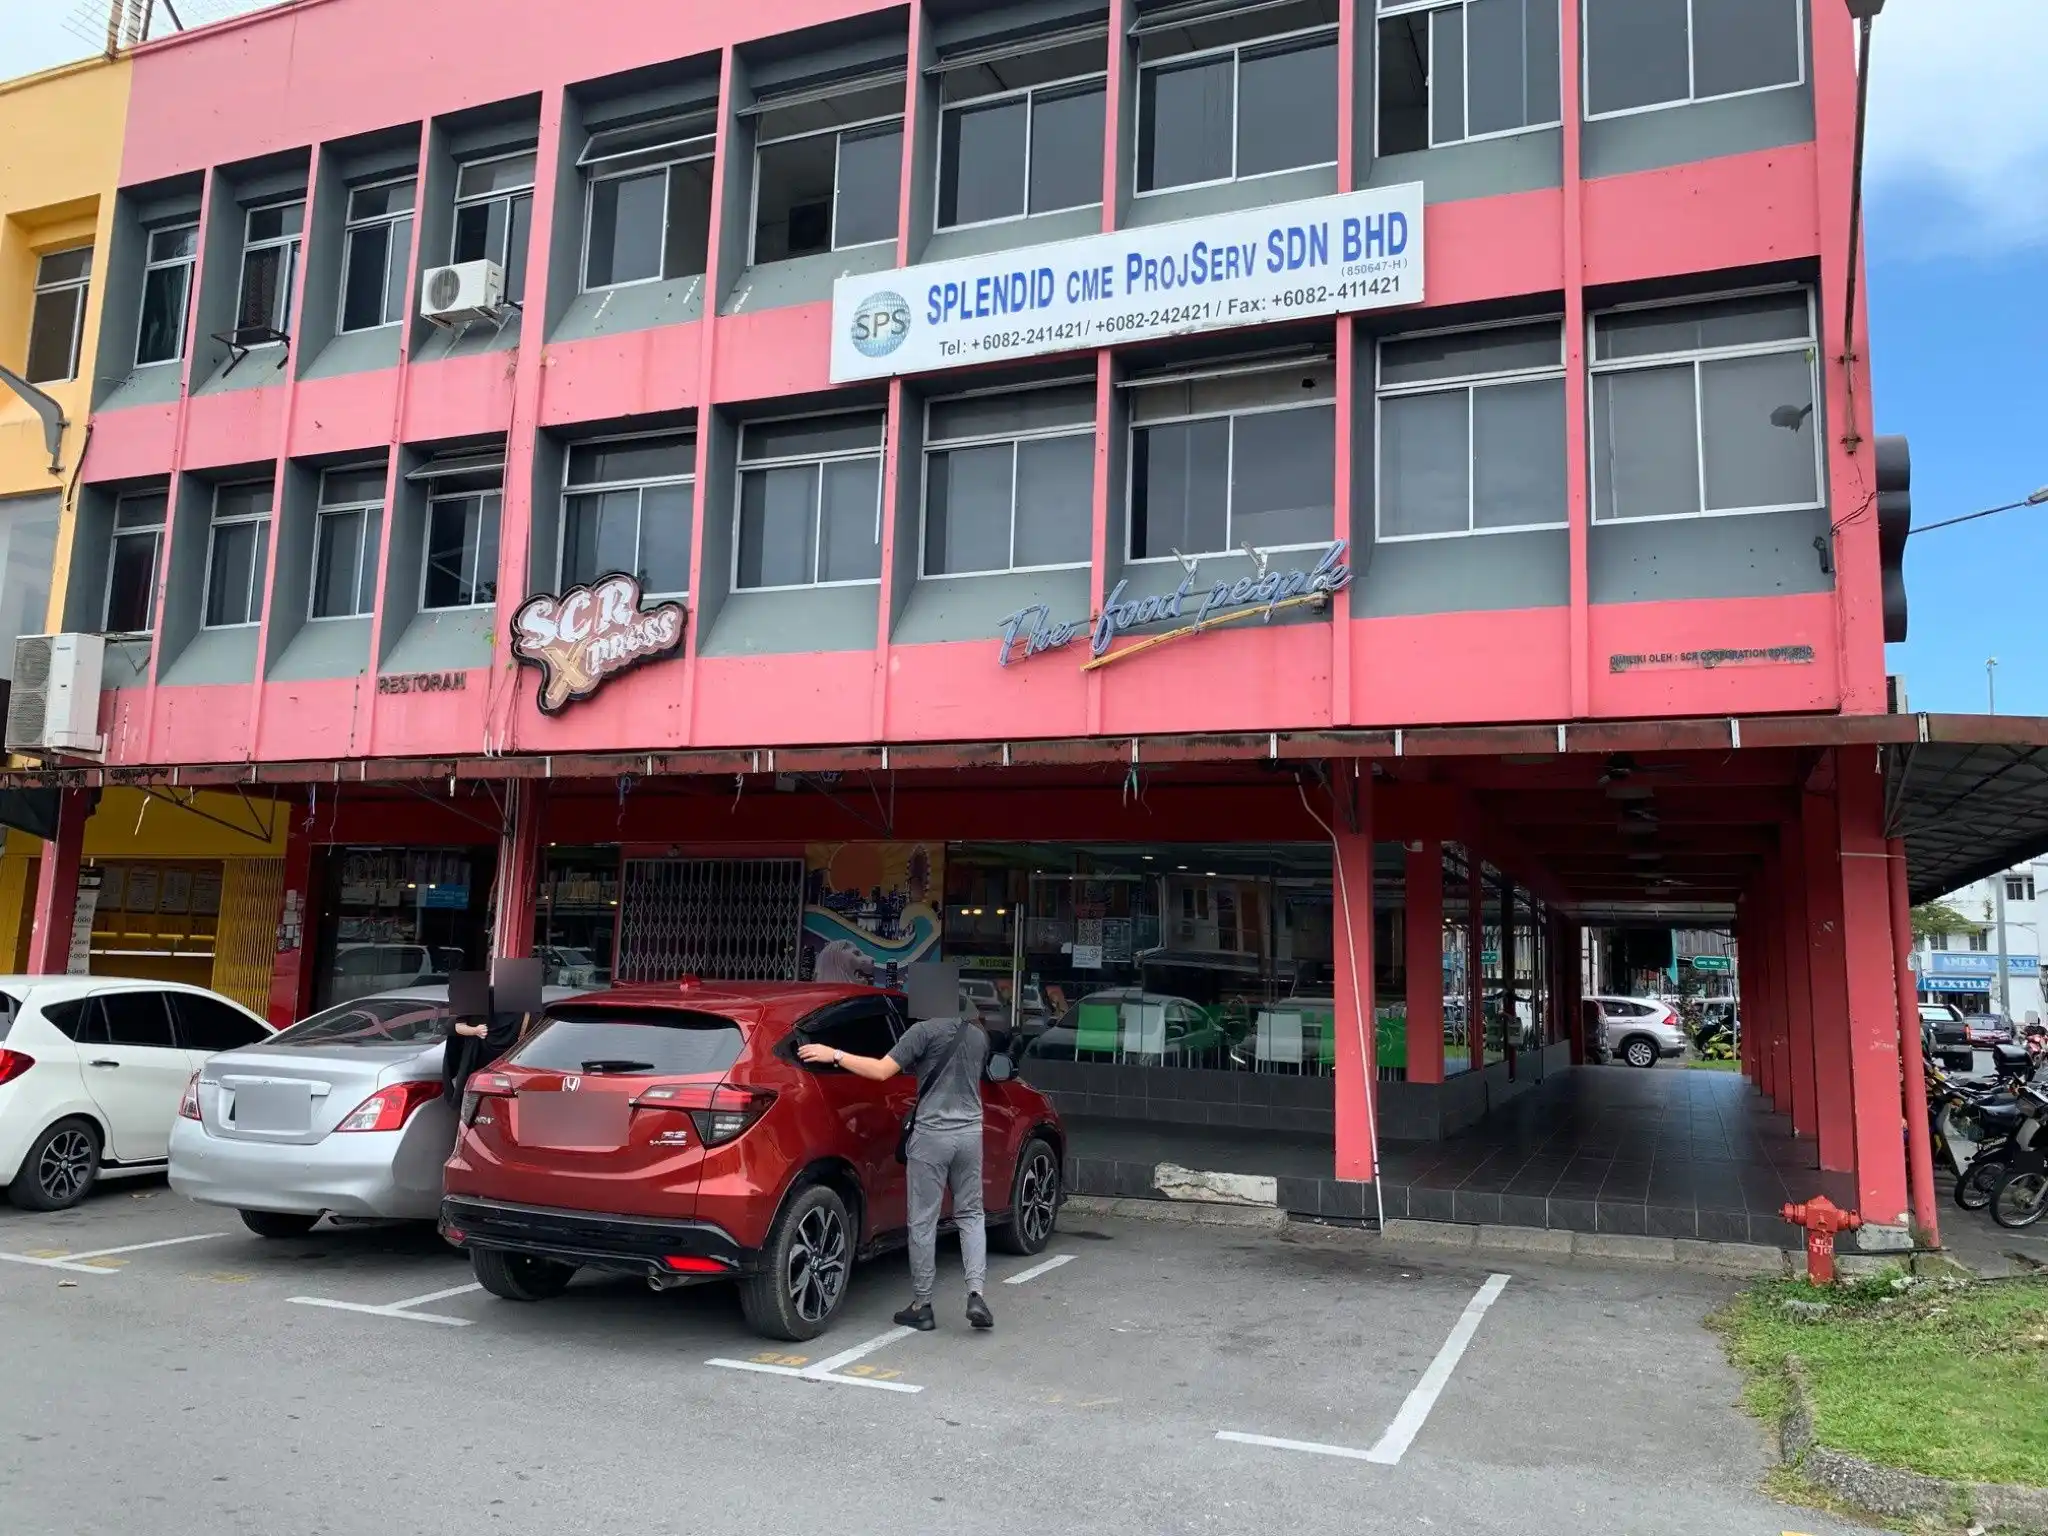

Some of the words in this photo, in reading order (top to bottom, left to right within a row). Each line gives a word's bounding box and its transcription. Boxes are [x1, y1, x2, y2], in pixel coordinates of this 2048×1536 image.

[927, 267, 1054, 325] SPLENDID
[1267, 222, 1328, 273] SDN
[1343, 211, 1407, 262] BHD
[852, 308, 906, 340] SPS
[940, 340, 966, 357] Tel:
[1095, 303, 1210, 332] +6082-242421
[1228, 297, 1266, 315] Fax:
[1272, 275, 1399, 307] +6082-411421
[518, 580, 633, 649] SCR
[998, 603, 1076, 667] The
[1092, 560, 1197, 656] food
[1193, 539, 1350, 634] people
[1648, 653, 1672, 663] OLEH
[377, 671, 467, 694] RESTORAN
[1943, 956, 1988, 967] ANEKA
[1927, 979, 1989, 989] TEXTILE
